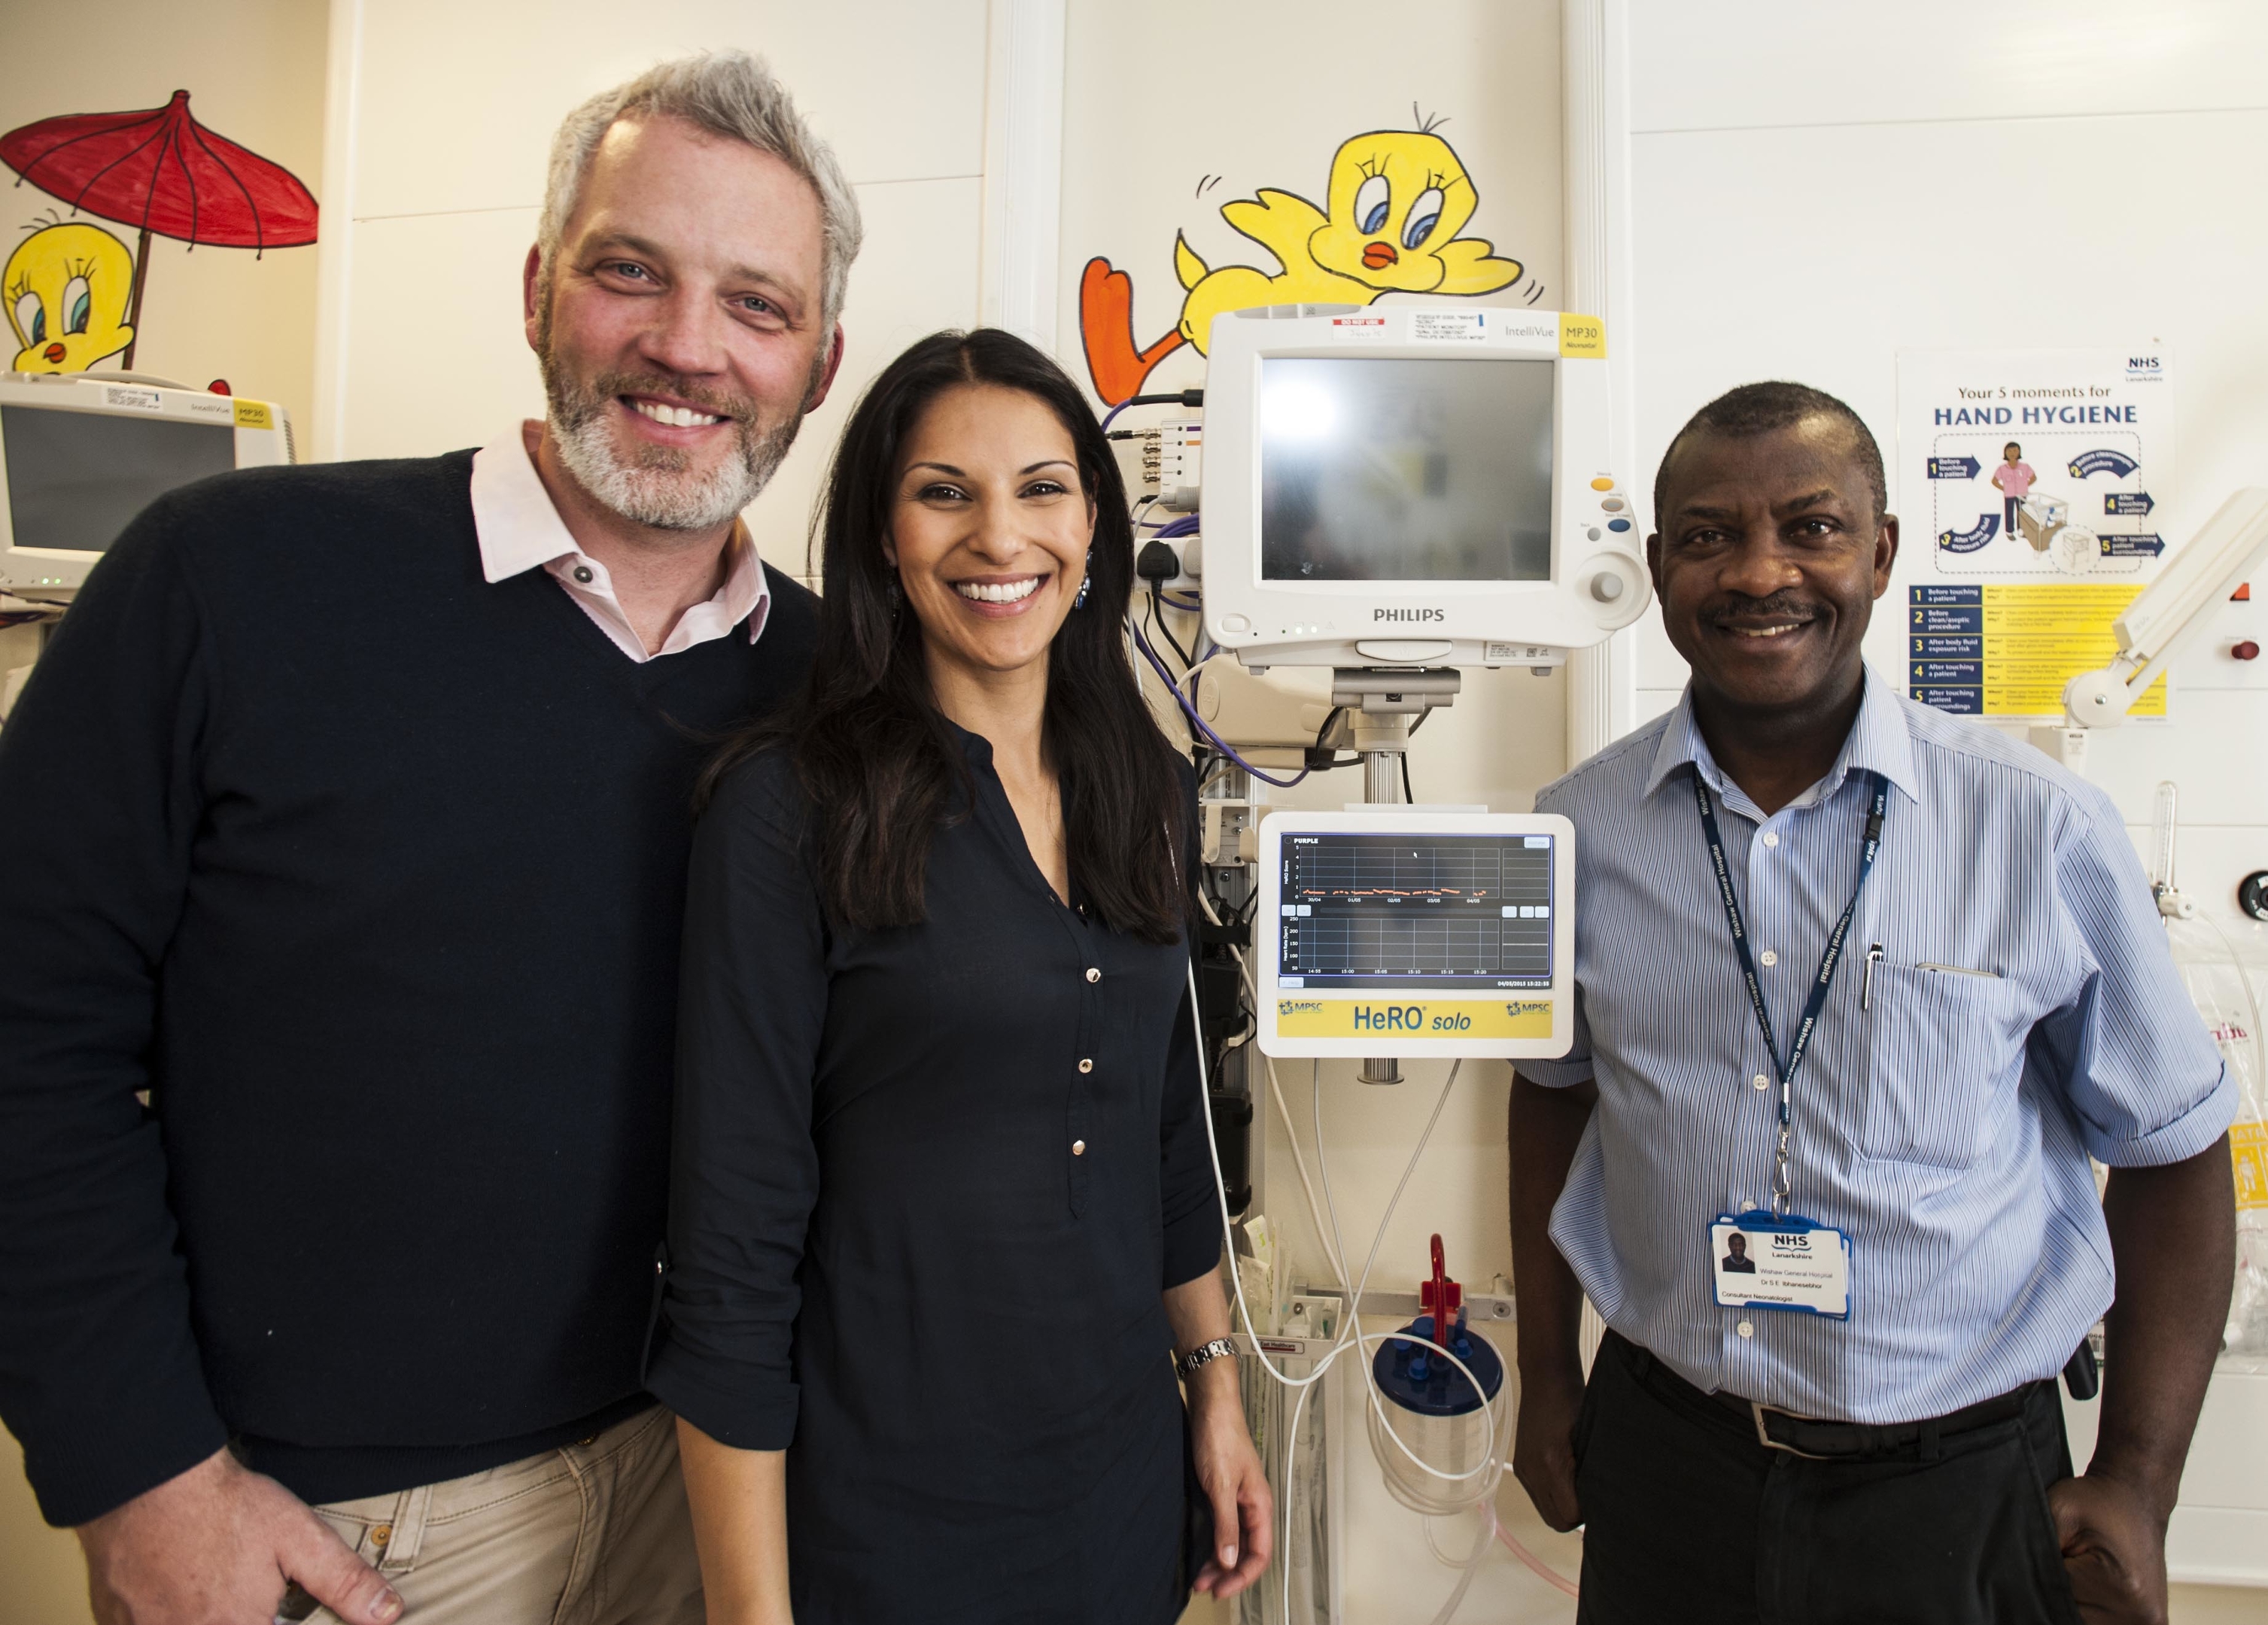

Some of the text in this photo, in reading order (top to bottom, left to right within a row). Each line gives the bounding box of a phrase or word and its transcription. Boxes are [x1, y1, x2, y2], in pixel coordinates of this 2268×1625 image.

[1506, 326, 1555, 337] IntelliVue
[1566, 327, 1597, 338] MP30
[2130, 357, 2159, 367] NHS
[1958, 384, 2111, 399] Your 5 moments for
[1935, 405, 2138, 426] HAND HYGIENE
[1930, 463, 1937, 475] 1
[2070, 466, 2083, 478] 2
[2107, 498, 2115, 510] 4
[1941, 533, 1951, 545] 3
[2102, 540, 2110, 552] 5
[1914, 589, 1921, 601] 1
[1950, 588, 1978, 597] touching
[1374, 609, 1445, 621] PHILIPS
[1914, 611, 1923, 624] 2
[1915, 639, 1923, 652] 3
[1914, 665, 1923, 677] 4
[1945, 664, 1975, 672] touching
[1915, 691, 1923, 703] 5
[1711, 843, 1743, 939] Wishaw General Hospital
[1820, 915, 1850, 984] General Hospital
[1295, 1003, 1322, 1011] MPSC
[1522, 1004, 1549, 1012] MPSC
[1746, 971, 1771, 1040] General Hospital
[1432, 1012, 1471, 1030] solo
[1795, 1016, 1814, 1051] Wishaw
[1774, 1235, 1808, 1246] NHS
[1771, 1252, 1813, 1260] Lanarkshire
[1784, 1269, 1807, 1277] General
[1809, 1271, 1833, 1279] Hospital
[1753, 1293, 1793, 1302] Neonatologist
